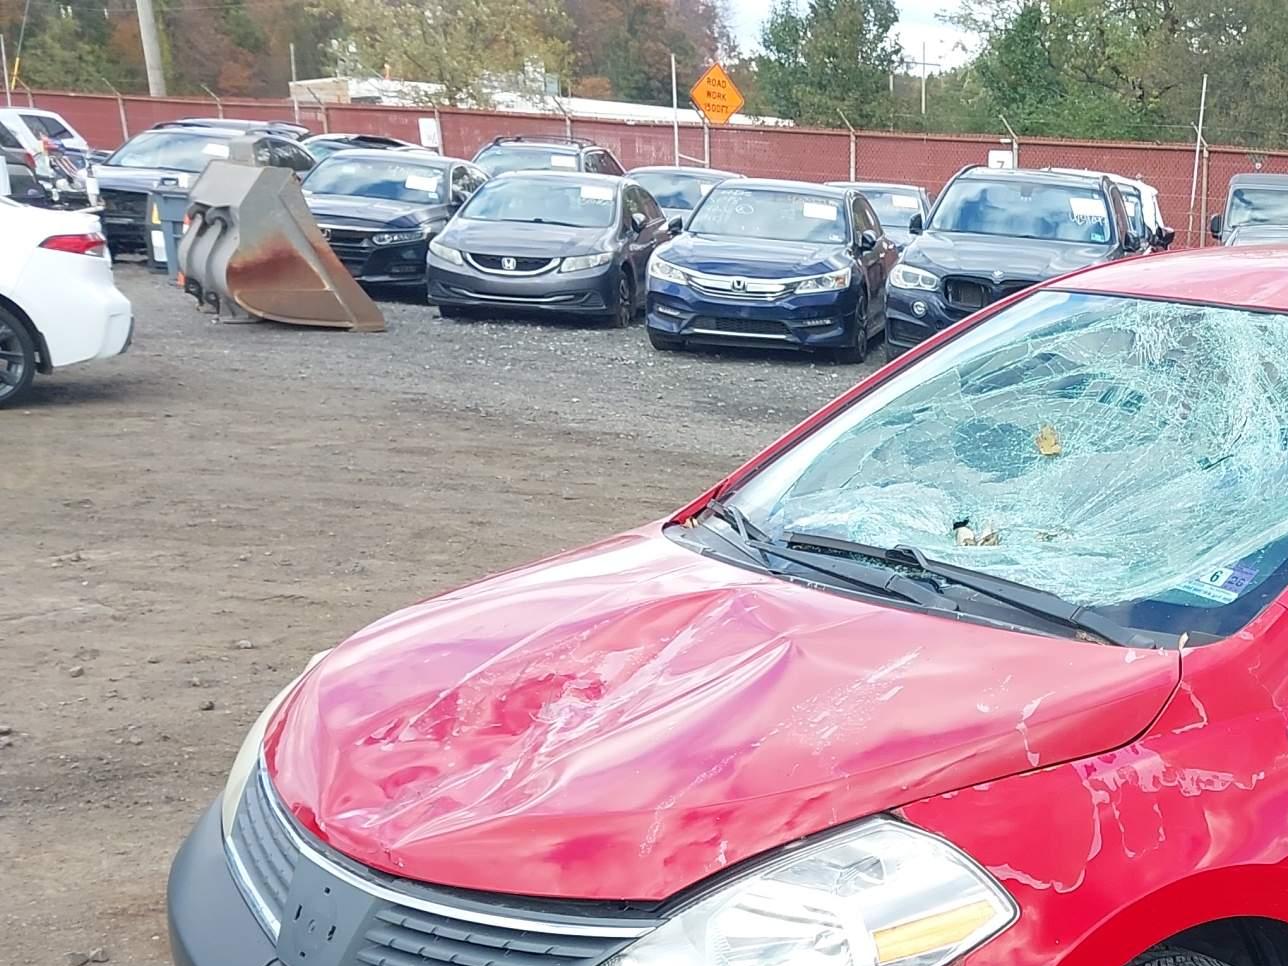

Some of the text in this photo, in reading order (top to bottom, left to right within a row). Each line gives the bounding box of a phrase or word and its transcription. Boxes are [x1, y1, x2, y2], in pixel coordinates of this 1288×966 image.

[706, 77, 727, 89] ROAD
[706, 90, 727, 101] WORK
[1209, 570, 1224, 583] 6
